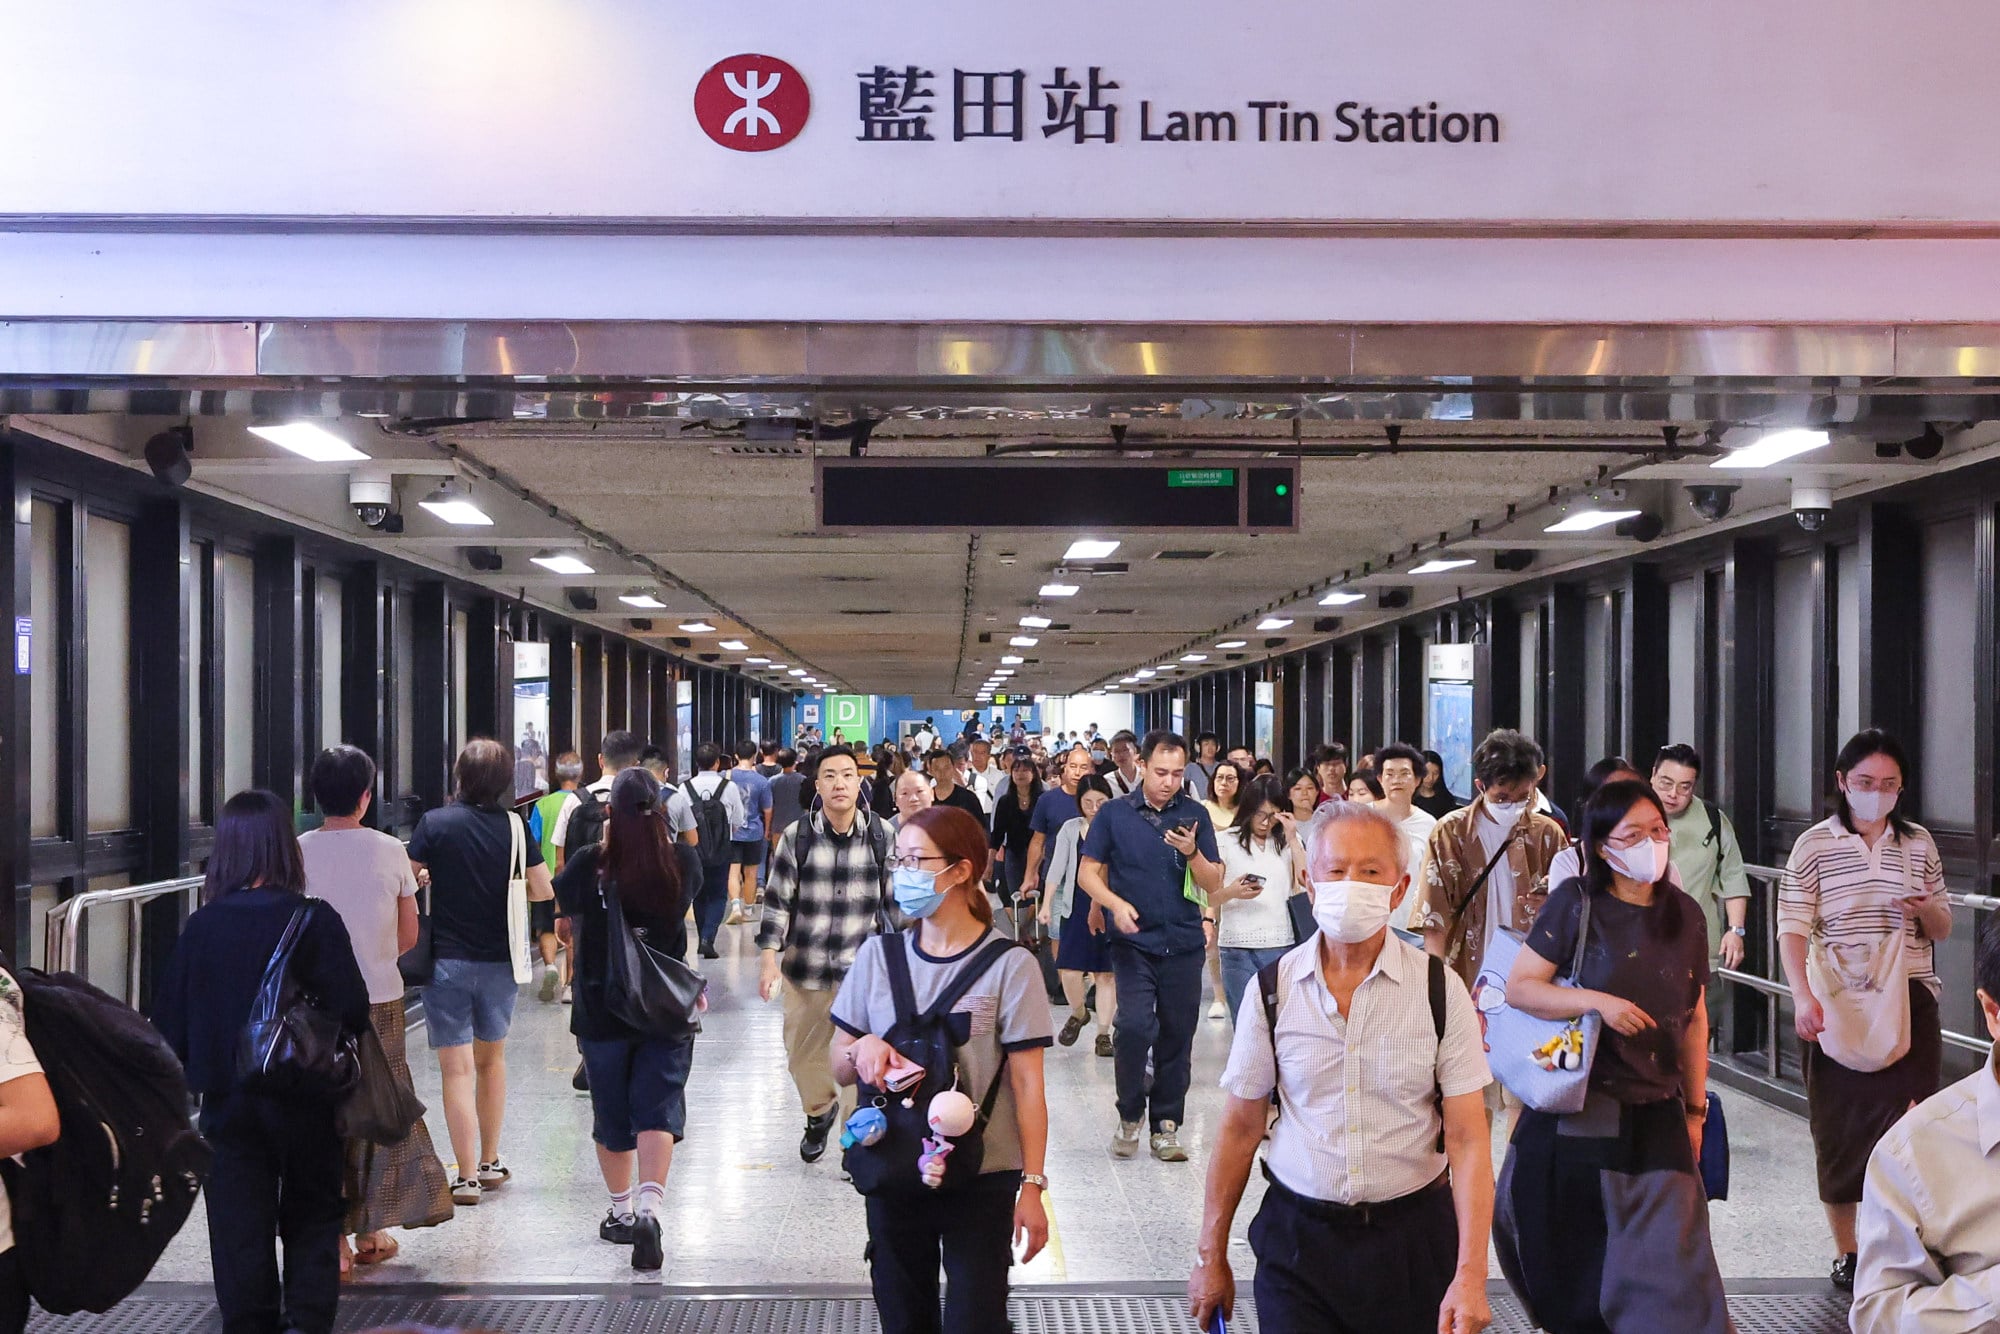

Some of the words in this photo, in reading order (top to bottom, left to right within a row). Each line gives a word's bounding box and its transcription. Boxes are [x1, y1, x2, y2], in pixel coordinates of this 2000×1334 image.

[855, 65, 1121, 145] 藍田站
[1140, 100, 1237, 142] Lam
[1247, 100, 1319, 142] Tin
[1334, 101, 1500, 143] Station
[839, 701, 856, 721] D
